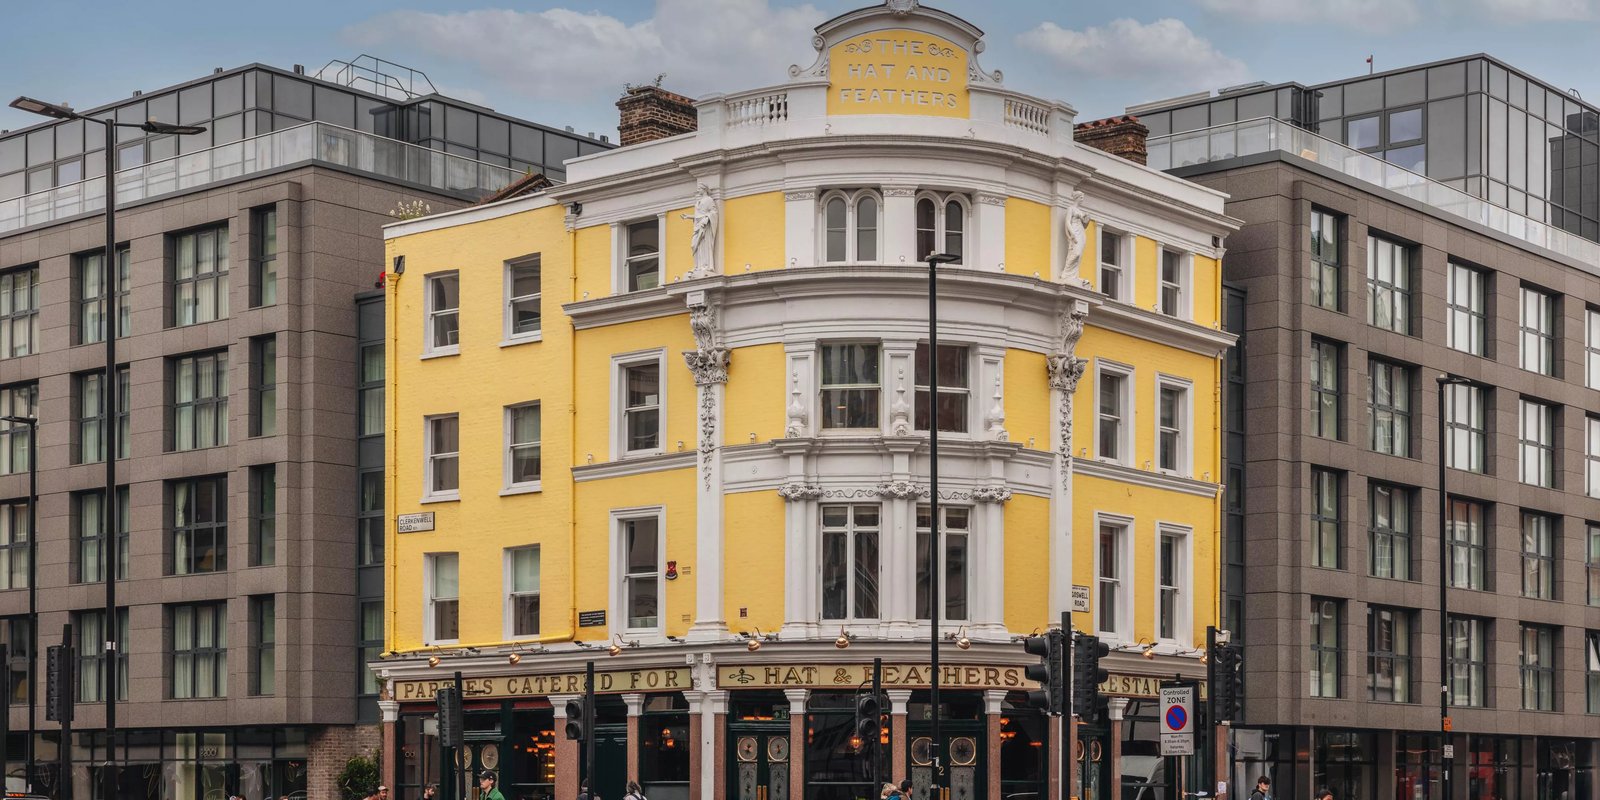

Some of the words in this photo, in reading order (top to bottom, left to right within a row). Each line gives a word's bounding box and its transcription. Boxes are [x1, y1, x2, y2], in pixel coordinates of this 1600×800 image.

[876, 39, 924, 56] THE
[848, 63, 895, 80] HAT
[906, 65, 951, 83] AND
[840, 88, 958, 109] FEATHERS
[400, 516, 432, 525] CLERKENWELL
[1074, 599, 1085, 607] ROAD
[404, 679, 493, 698] PARES
[630, 670, 678, 689] FOR
[764, 666, 817, 685] HAT
[833, 667, 852, 684] &
